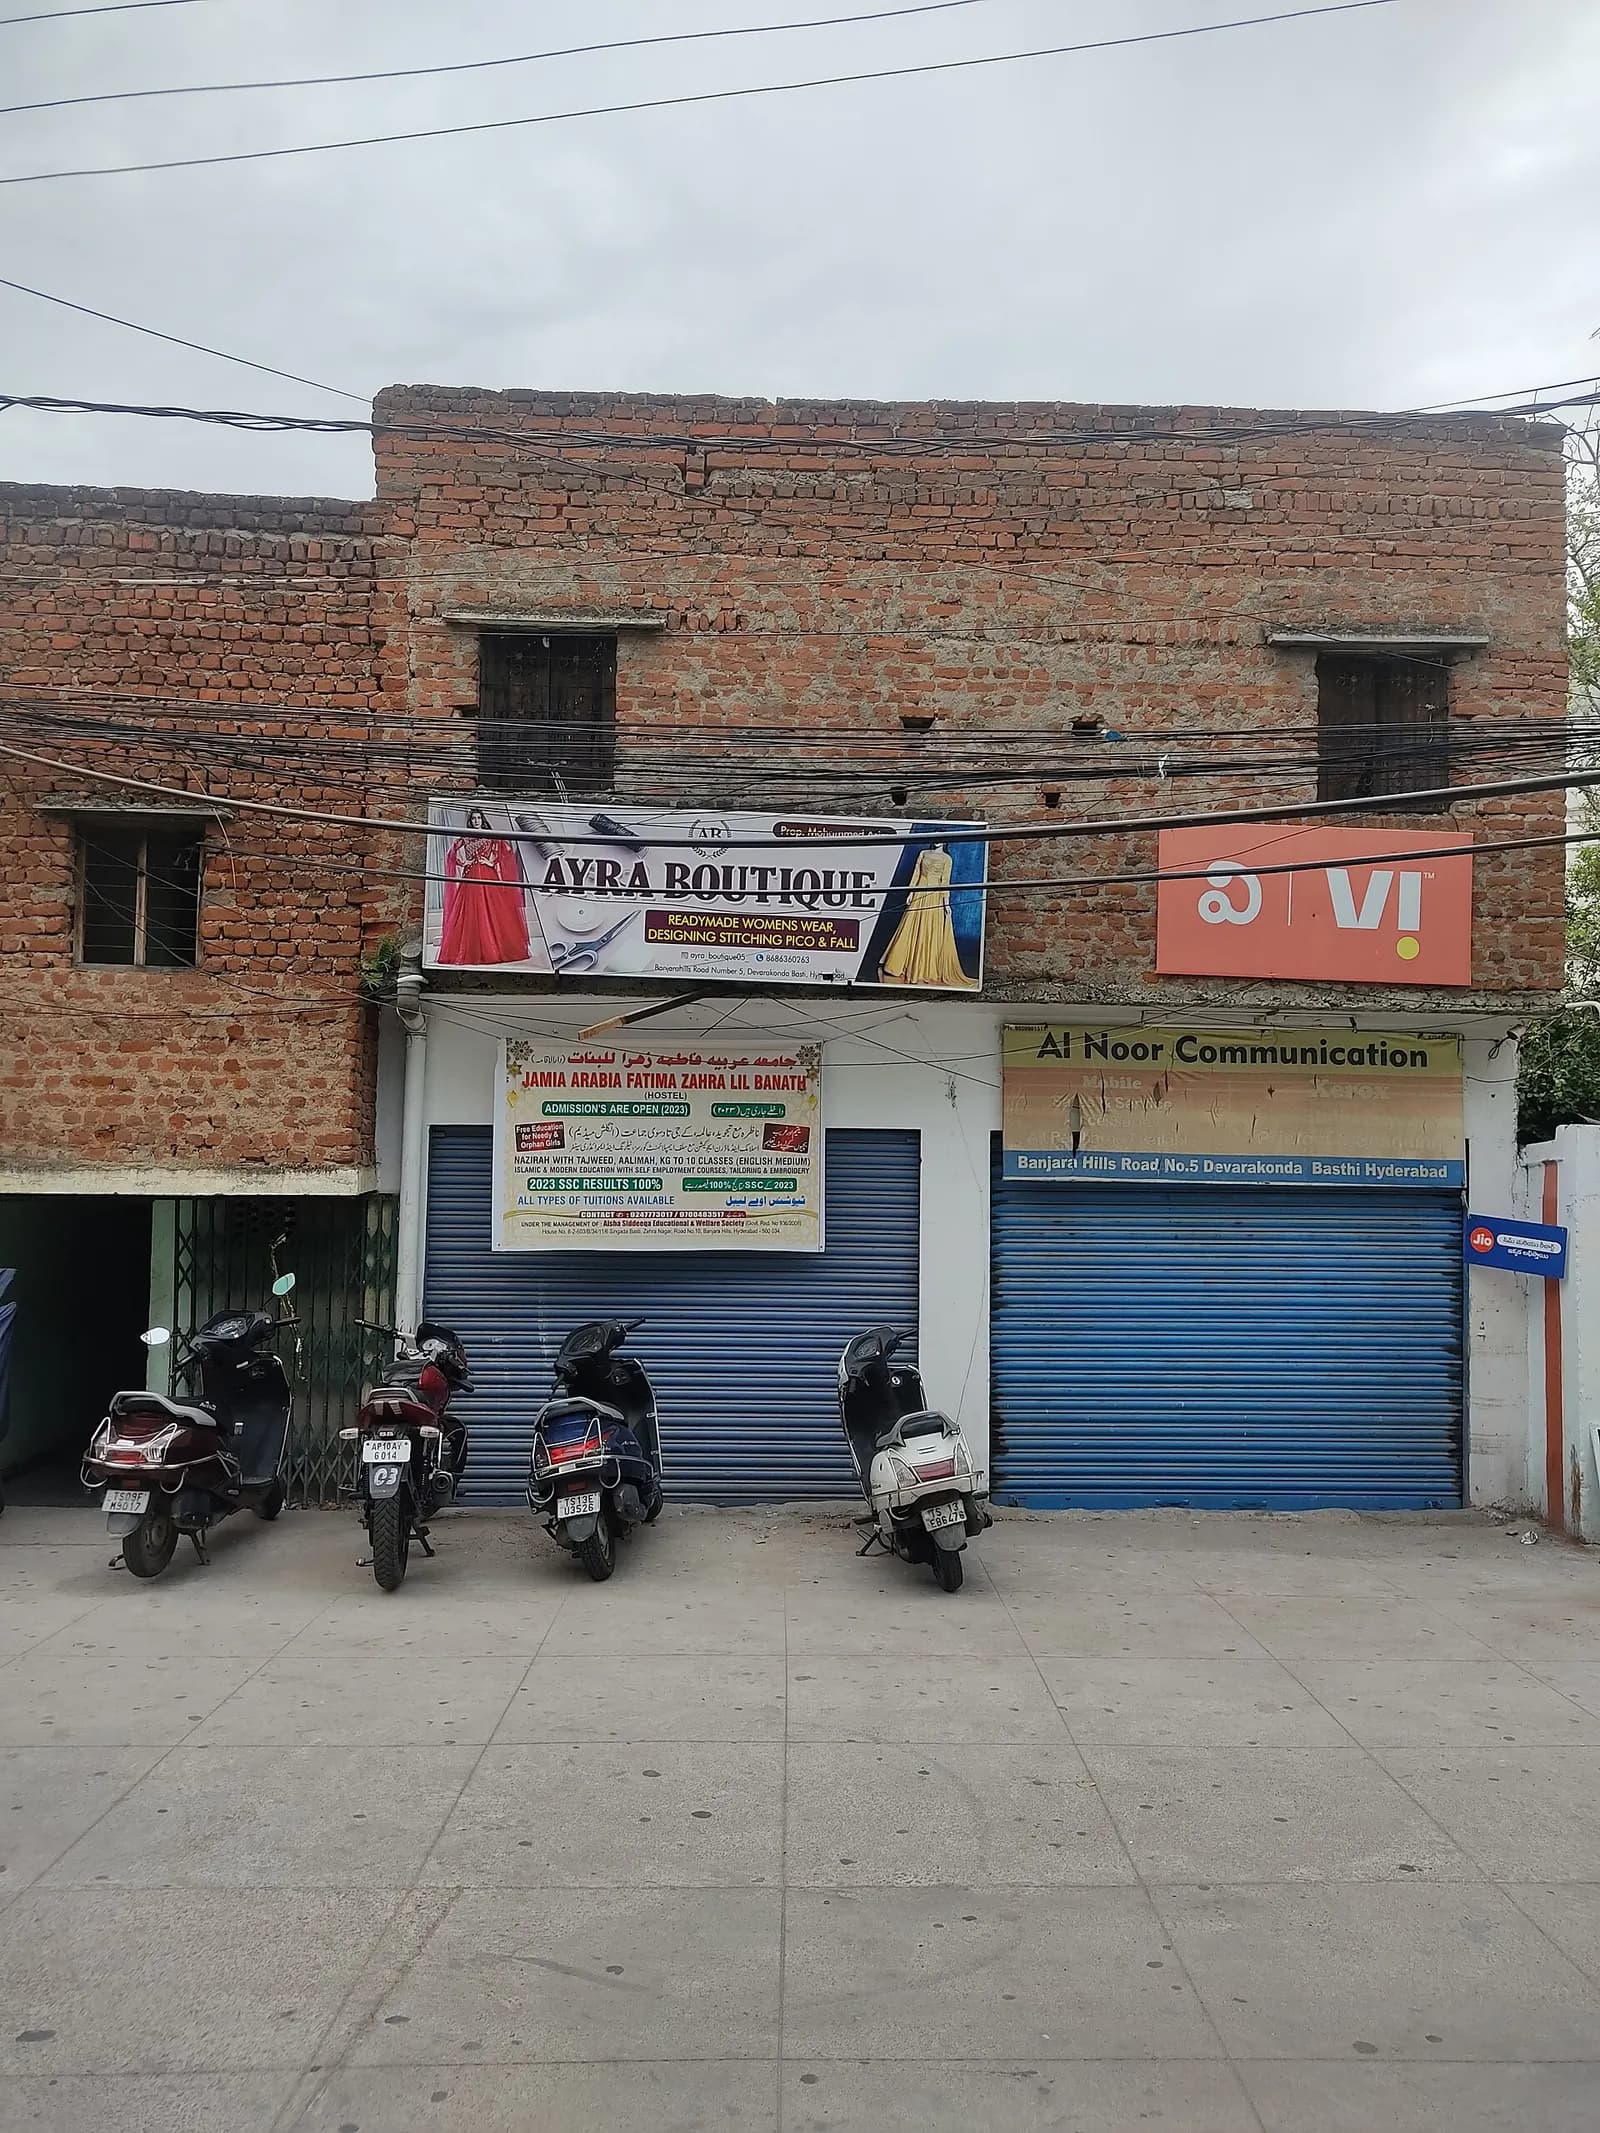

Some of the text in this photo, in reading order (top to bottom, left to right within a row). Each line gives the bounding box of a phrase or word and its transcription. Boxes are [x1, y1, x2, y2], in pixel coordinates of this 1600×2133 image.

[780, 825, 806, 837] Prop.
[540, 857, 876, 911] AYRA BOUTIQUE
[668, 914, 837, 935] READYMADE WOMENS WEAR,
[648, 928, 857, 949] DESIGNING STITCHING PICO & FALL
[766, 954, 810, 964] 8686360263
[693, 965, 710, 974] Road
[711, 966, 738, 976] Number
[747, 967, 790, 979] Devarakonda
[1037, 1031, 1428, 1067] Al Noor Communication
[522, 1071, 808, 1092] JAMIA ARABIA FATIMA ZAHRA LIL BANATH
[645, 1091, 688, 1101] (HOSTEL)
[544, 1103, 689, 1116] ADMISSION'S ARE OPEN (2023)
[516, 1122, 564, 1134] Free Education
[521, 1131, 532, 1141] for
[532, 1130, 552, 1141] Needy
[520, 1138, 561, 1151] Orphan Girls
[514, 1156, 811, 1167] NAZIRAH WITH TAJWEED, AALIMAH, KG TO 10 CLASSES (ENGLISH MEDIUM)
[1018, 1155, 1448, 1179] Banjara Hills Road No.5 Devarakonda Basthi Hyderabad
[514, 1166, 541, 1174] ISLAMIC
[549, 1166, 578, 1174] MODERN
[579, 1166, 615, 1174] EDUCATION
[616, 1166, 634, 1174] WITH
[652, 1166, 695, 1175] EMPLOYMENT
[729, 1167, 762, 1175] TAILORING
[769, 1167, 810, 1175] EMBROIDERY
[529, 1178, 662, 1190] 2023 SSC RESULTS 100%
[744, 1181, 764, 1189] SSC
[774, 1181, 794, 1189] 2023
[518, 1195, 675, 1205] ALL TYPES OF TUITIONS AVAILABLE
[581, 1211, 615, 1219] CONTACT
[653, 1219, 690, 1228] Educational
[721, 1220, 745, 1230] Society
[1473, 1233, 1492, 1247] Jio
[374, 1451, 397, 1460] 6014
[113, 1491, 143, 1502] TS09F
[565, 1494, 594, 1507] TS13E
[109, 1501, 141, 1511] M9017
[564, 1503, 594, 1515] U3526
[928, 1502, 959, 1518] TS 13
